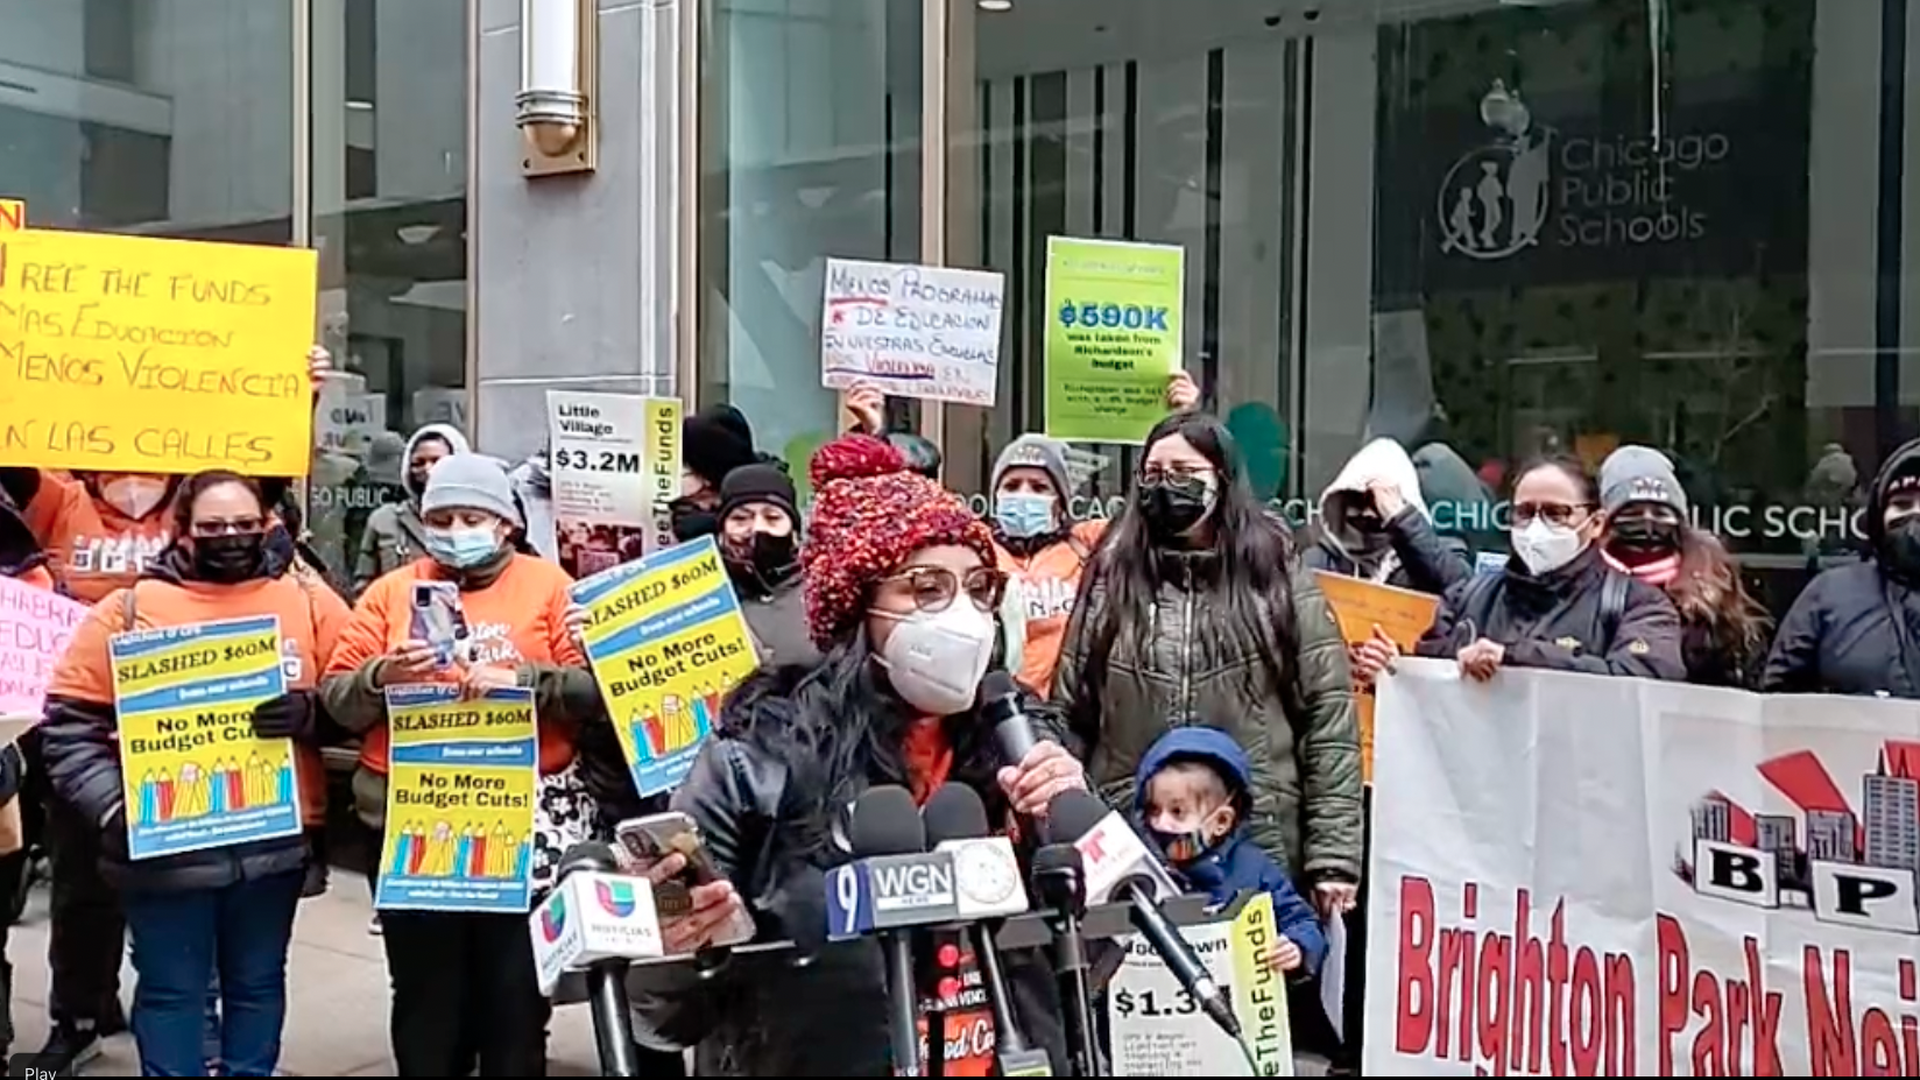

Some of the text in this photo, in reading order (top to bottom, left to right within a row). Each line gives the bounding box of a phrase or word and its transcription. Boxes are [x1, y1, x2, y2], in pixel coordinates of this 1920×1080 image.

[1561, 133, 1728, 169] Chicago
[1561, 169, 1673, 206] Public
[1558, 207, 1706, 246] Schools
[100, 269, 151, 297] THE
[170, 275, 271, 306] FUNDS
[1059, 299, 1168, 331] $590K
[117, 347, 299, 399] VIOLENCIA
[1091, 358, 1134, 371] budget
[559, 404, 600, 419] Little
[560, 420, 614, 437] Village
[48, 421, 115, 455] LAS
[134, 427, 274, 466] CALLES
[556, 447, 640, 474] $3.2M
[582, 581, 667, 631] SLASHED
[670, 555, 719, 589] $60M
[118, 635, 277, 683] SLASHED $60M
[609, 637, 747, 698] Budget Cuts!
[627, 631, 717, 673] No More
[156, 711, 254, 733] No More
[393, 709, 532, 731] SLASHED $60M
[130, 732, 216, 754] Budget
[395, 789, 528, 809] Budget Cuts!
[419, 772, 505, 790] No More
[874, 864, 951, 897] WGN
[1710, 847, 1763, 894] B
[837, 864, 858, 933] 9
[1834, 873, 1899, 917] P
[1396, 875, 1637, 1076] Brighton
[1656, 912, 1784, 1076] Park
